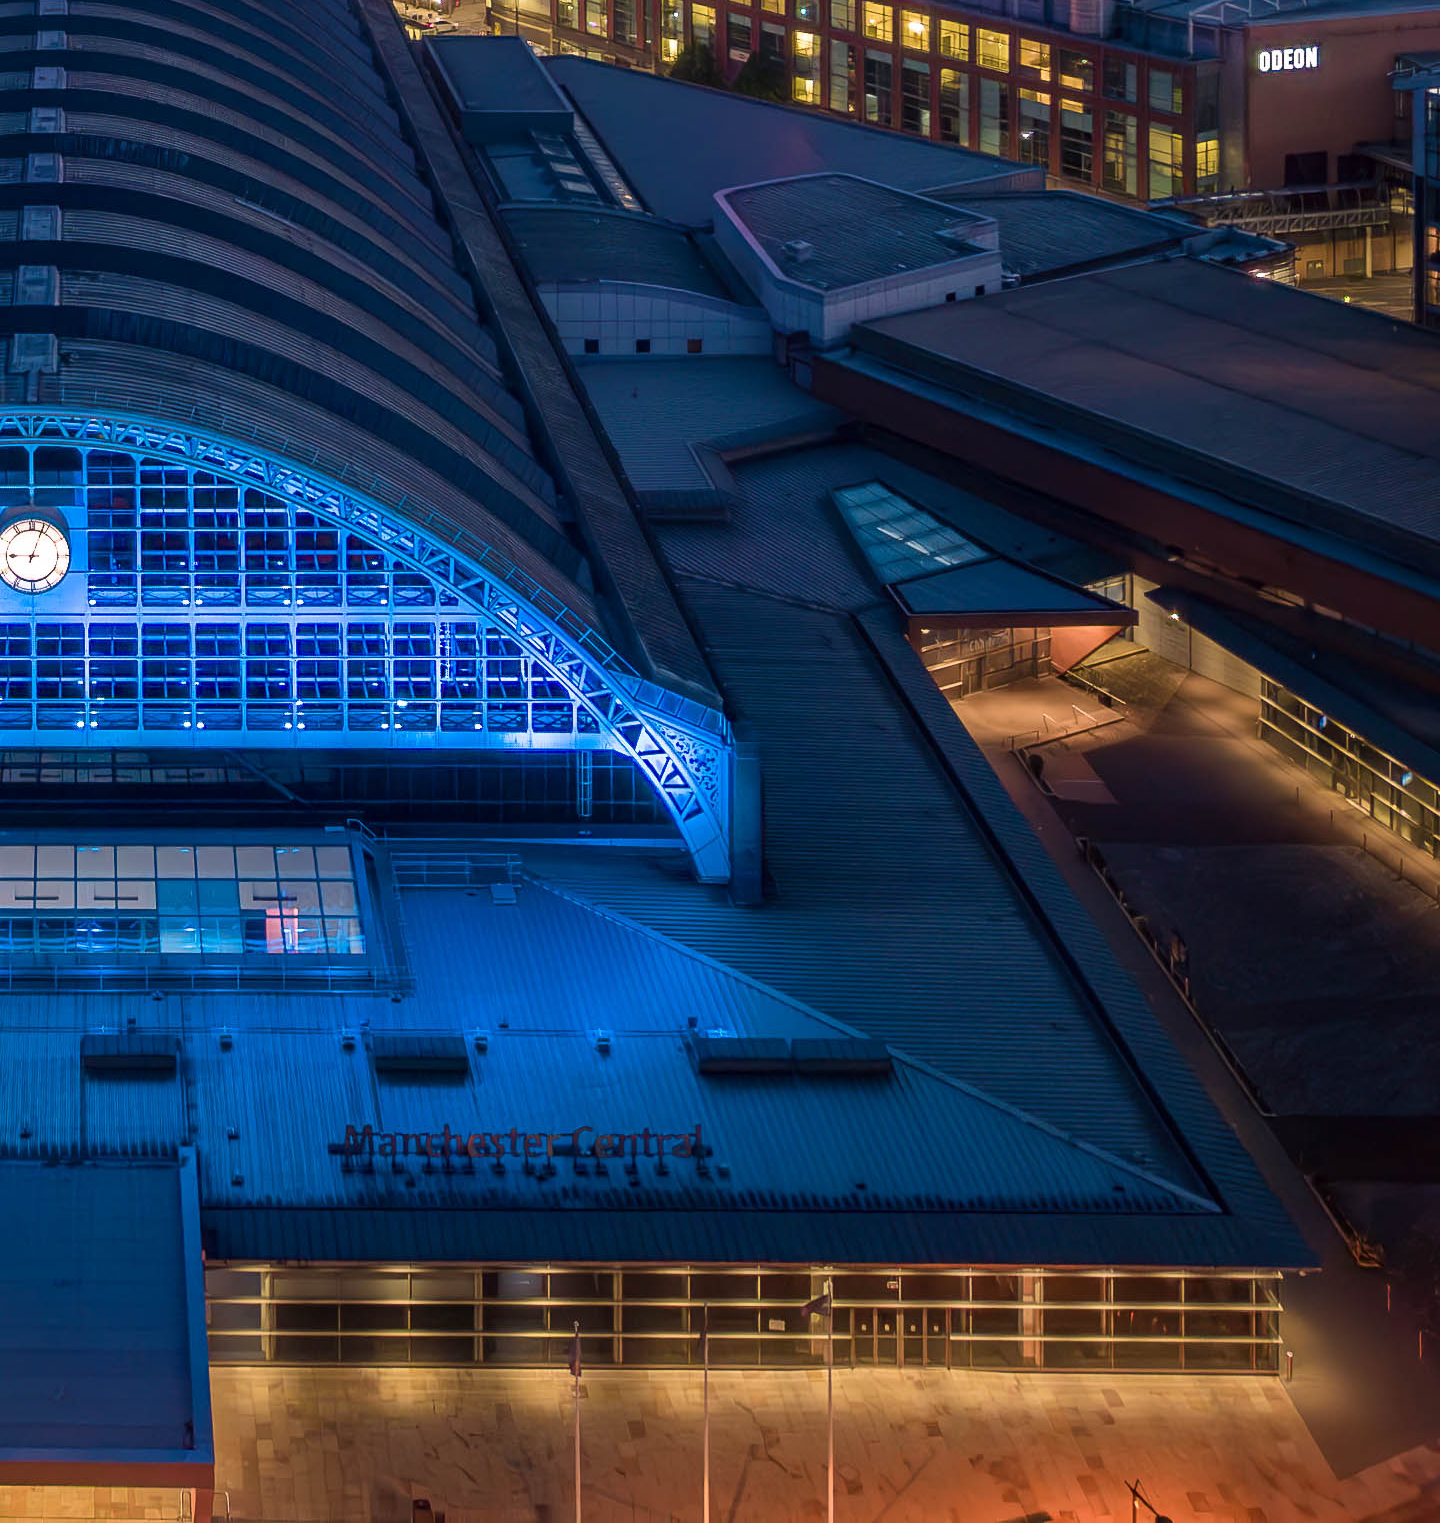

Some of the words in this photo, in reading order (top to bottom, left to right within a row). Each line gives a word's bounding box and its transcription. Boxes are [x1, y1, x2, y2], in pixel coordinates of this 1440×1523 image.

[1259, 46, 1318, 72] ODEON
[345, 1123, 560, 1158] Manchester
[573, 1124, 703, 1158] Central
